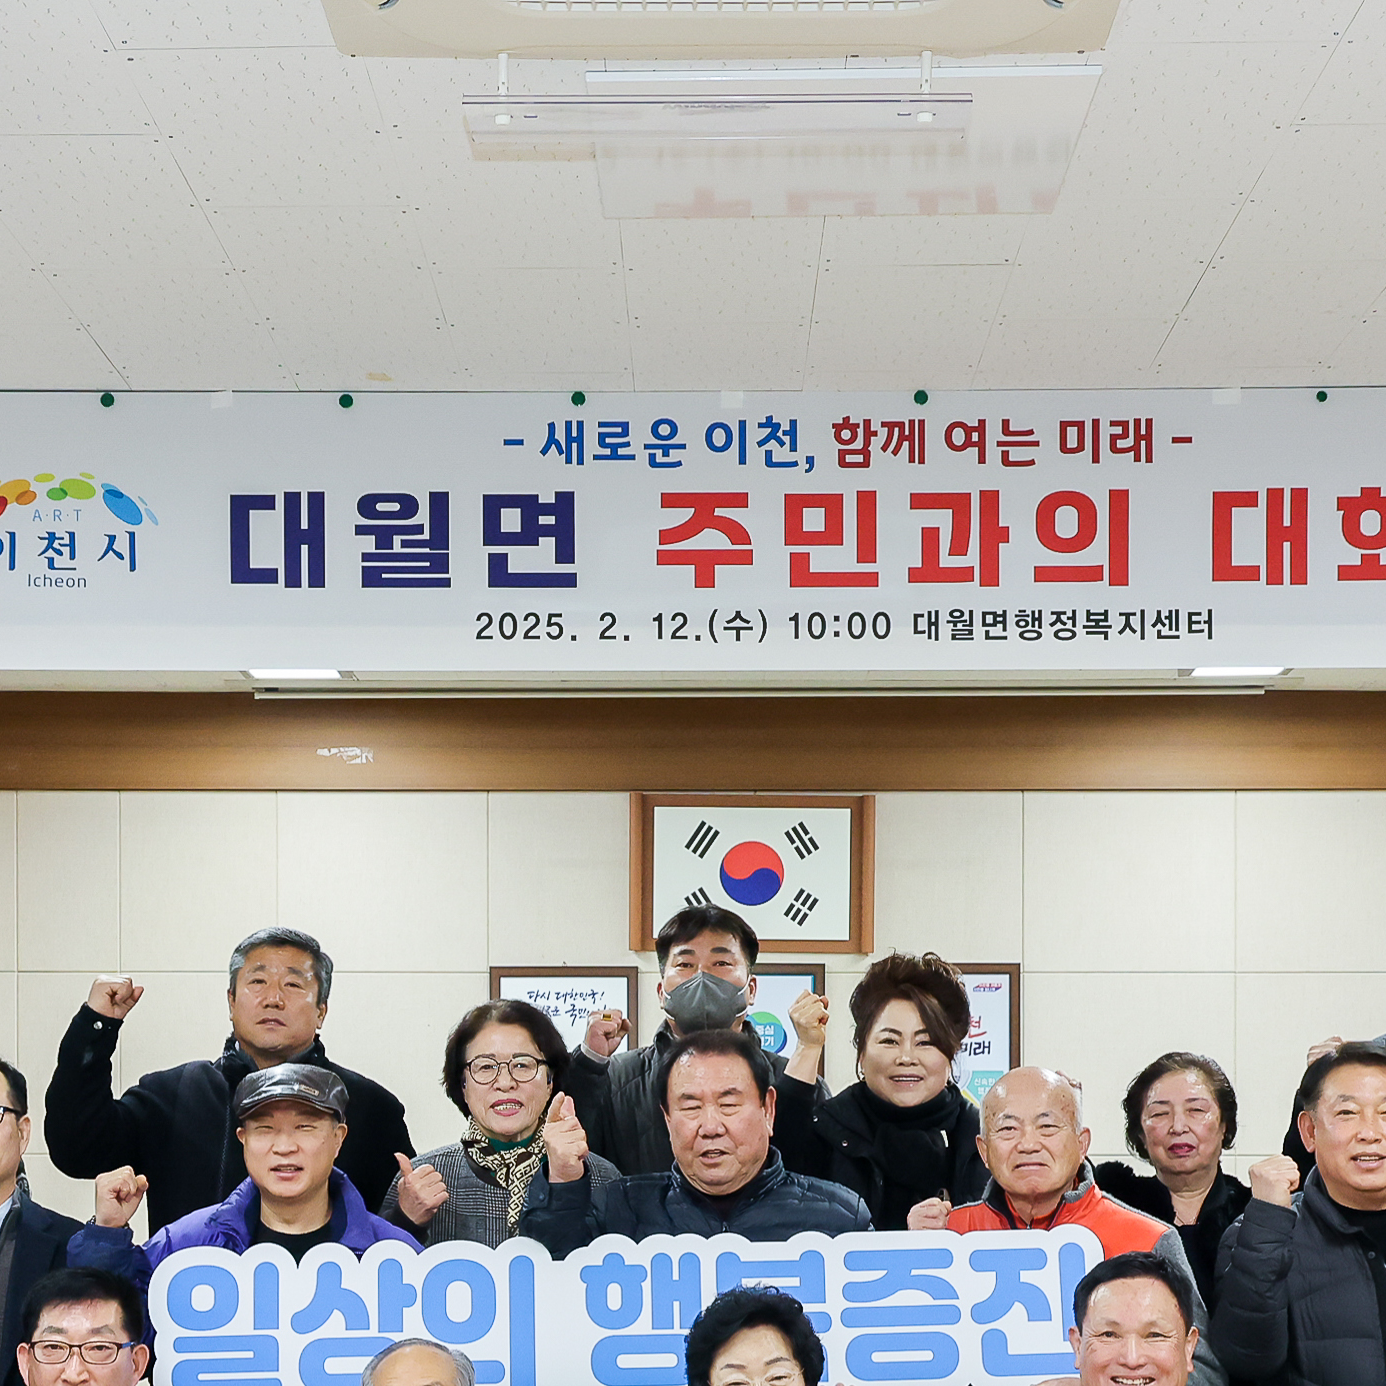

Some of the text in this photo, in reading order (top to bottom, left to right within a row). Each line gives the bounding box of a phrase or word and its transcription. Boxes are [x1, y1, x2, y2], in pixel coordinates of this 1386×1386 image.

[540, 418, 688, 469] 새로운
[705, 415, 816, 473] 이천,
[832, 416, 927, 469] 함께
[945, 419, 1042, 469] 여는
[1060, 418, 1155, 466] 미래
[230, 491, 579, 590] 대월면
[657, 488, 1131, 590] 주민과의
[27, 573, 88, 589] Icheon
[476, 608, 1215, 645] 2025. 2. 12.(수) 10:00 대월면행정복지센터
[527, 988, 605, 1005] 다시 대한민국!
[565, 1003, 589, 1027] 국민
[961, 1040, 991, 1057] 미래
